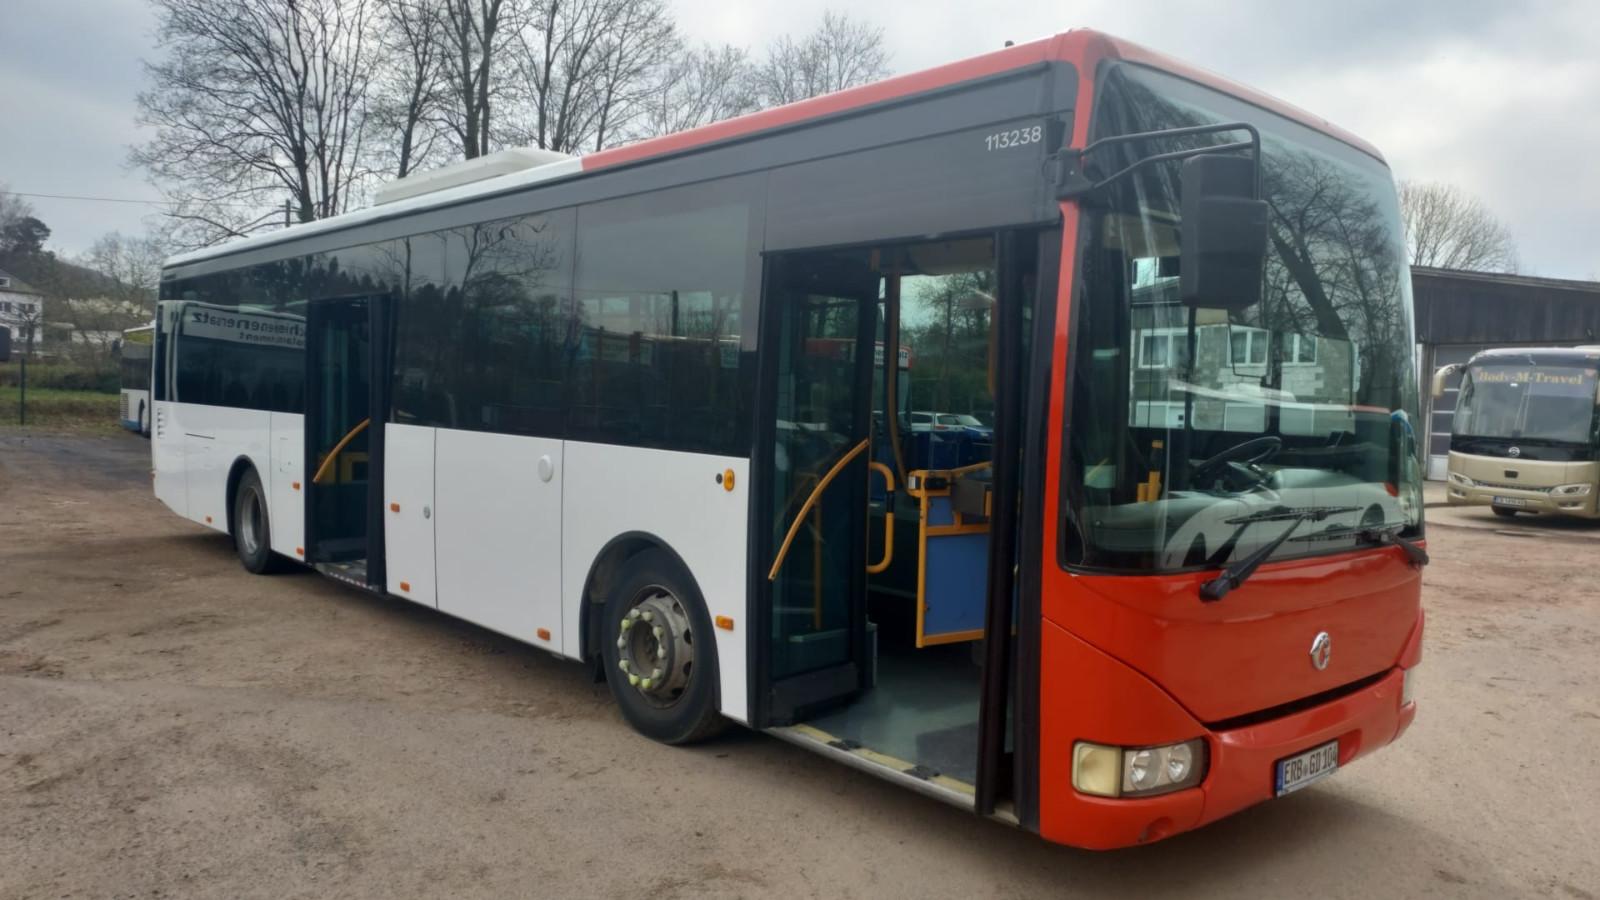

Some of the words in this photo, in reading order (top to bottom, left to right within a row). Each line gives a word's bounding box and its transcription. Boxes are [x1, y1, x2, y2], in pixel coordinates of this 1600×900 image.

[985, 126, 1042, 151] 113238
[1284, 759, 1303, 784] ERB
[1322, 746, 1337, 769] 104
